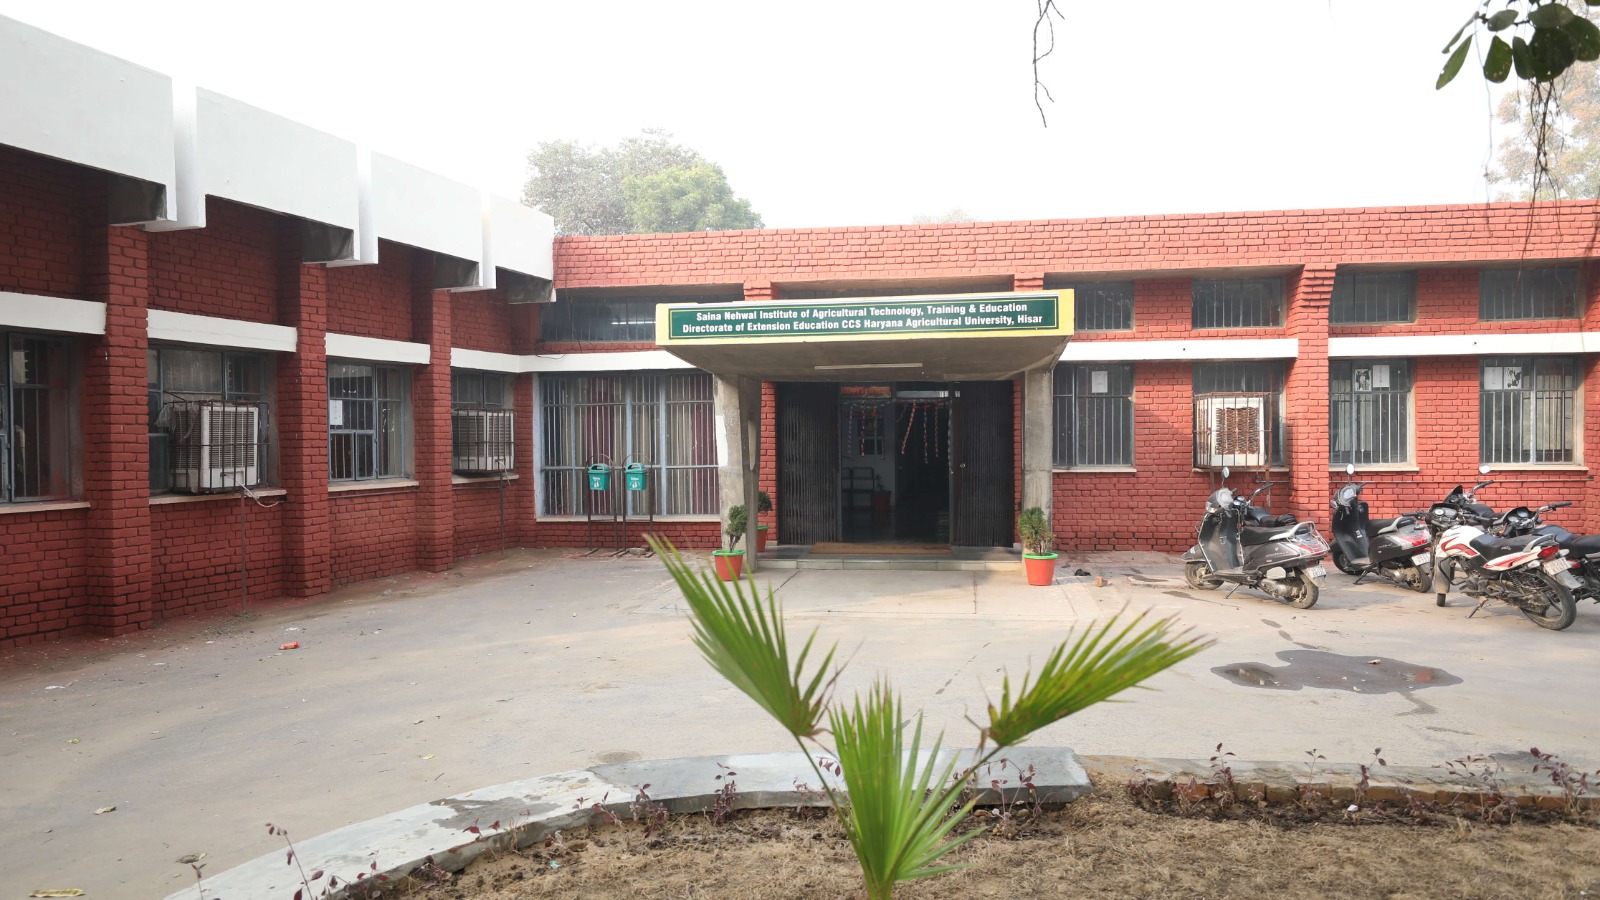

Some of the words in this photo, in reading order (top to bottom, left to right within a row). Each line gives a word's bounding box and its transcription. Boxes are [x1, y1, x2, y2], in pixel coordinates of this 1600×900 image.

[696, 312, 721, 321] Saina
[724, 311, 757, 320] Nehwal
[760, 310, 798, 319] Institute
[800, 309, 810, 318] of
[812, 308, 867, 319] Agricultural
[869, 305, 924, 316] Technology,
[926, 304, 966, 315] Training
[968, 304, 976, 313] &
[979, 303, 1027, 313] Education
[682, 323, 733, 333] Directorate
[735, 322, 745, 331] of
[747, 322, 791, 331] Extension
[793, 320, 839, 330] Education
[841, 319, 861, 328] CCS
[863, 319, 903, 329] Haryana
[905, 317, 962, 328] Agricultural
[964, 315, 1015, 326] University,
[1017, 314, 1043, 324] Hisar
